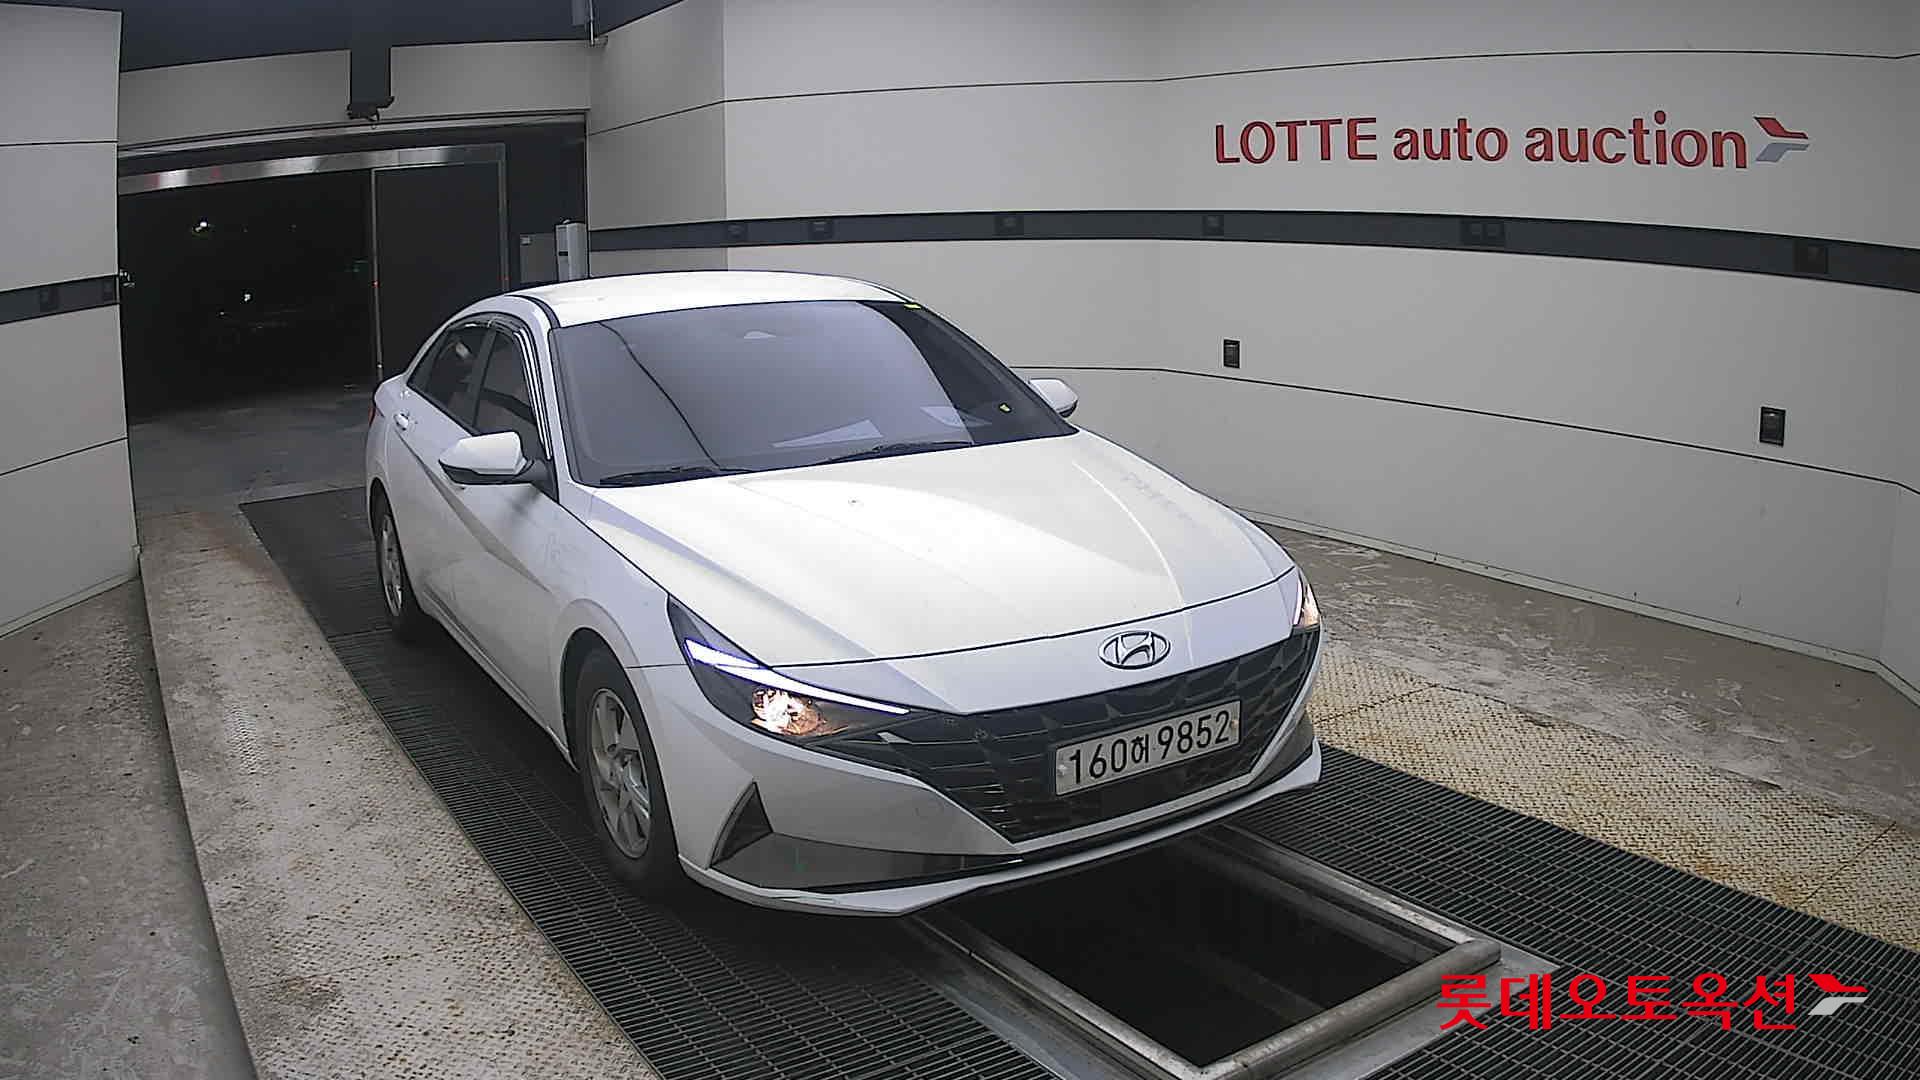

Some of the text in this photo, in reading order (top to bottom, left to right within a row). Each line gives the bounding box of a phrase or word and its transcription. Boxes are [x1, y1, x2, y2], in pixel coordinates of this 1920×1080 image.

[1215, 110, 1748, 169] LOTTE auto auction
